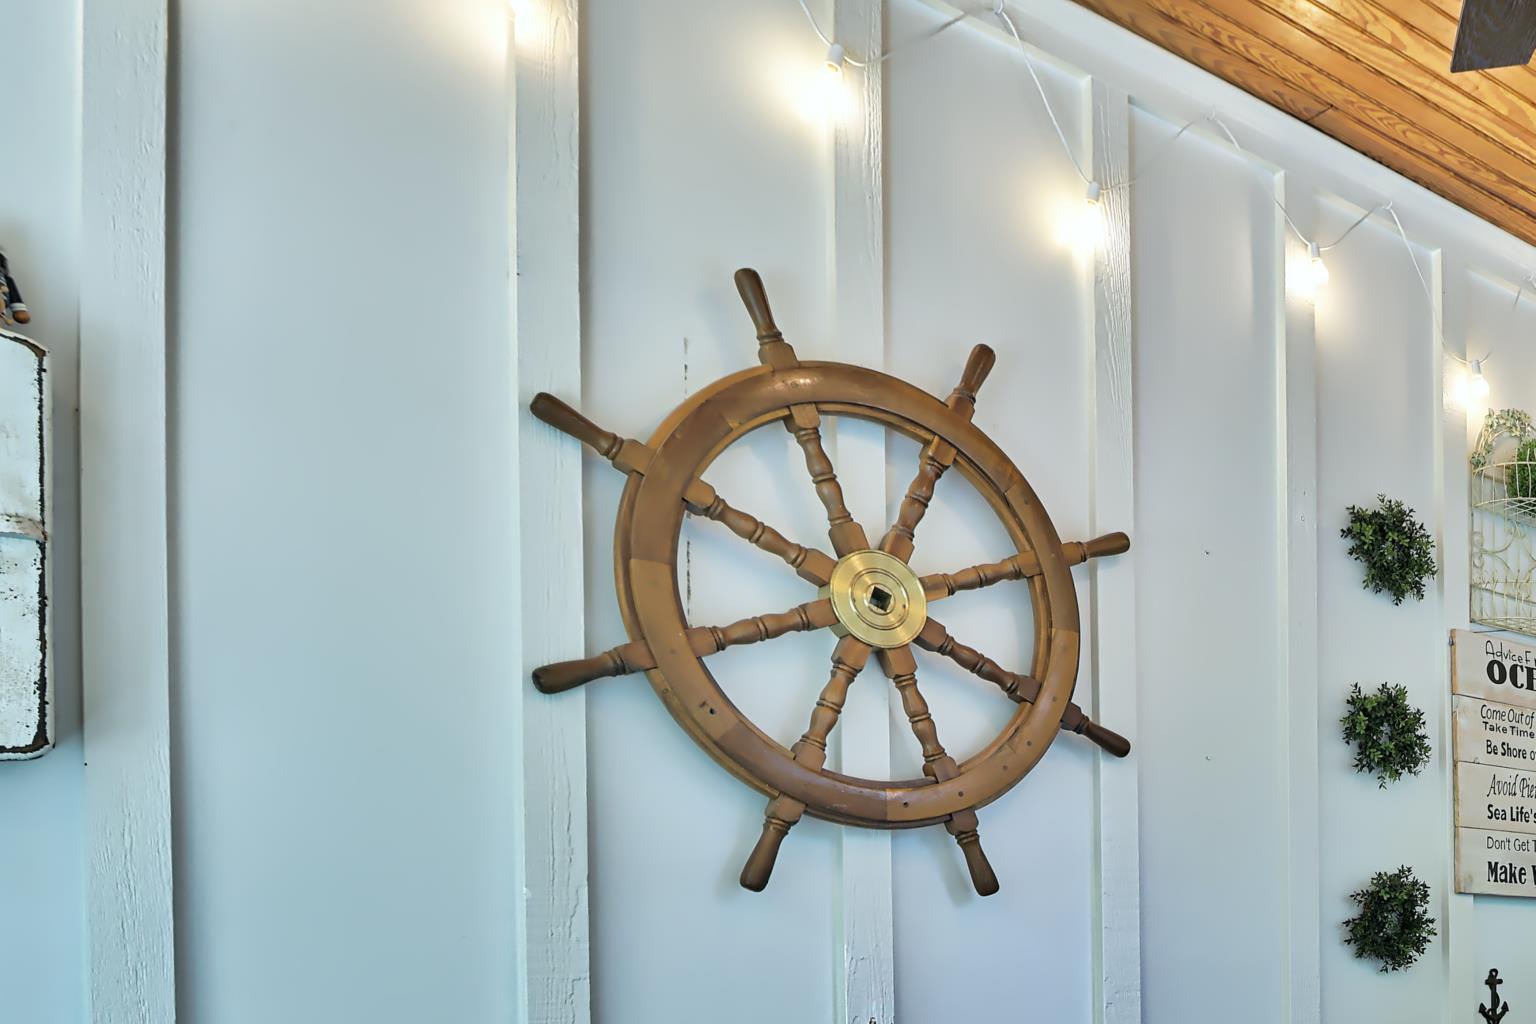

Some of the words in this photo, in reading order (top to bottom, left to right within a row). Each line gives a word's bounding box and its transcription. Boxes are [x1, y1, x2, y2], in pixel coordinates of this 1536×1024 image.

[1486, 640, 1523, 663] Advice
[1480, 704, 1506, 721] Come
[1508, 708, 1524, 724] Out
[1525, 712, 1535, 729] of
[1482, 721, 1508, 734] Take
[1509, 725, 1535, 739] Time
[1486, 739, 1498, 755] Be
[1501, 741, 1527, 759] Shore
[1486, 773, 1519, 797] Avoid
[1487, 804, 1507, 821] Sea
[1486, 836, 1511, 851] Don't
[1513, 838, 1530, 852] Get
[1487, 861, 1527, 884] Make
